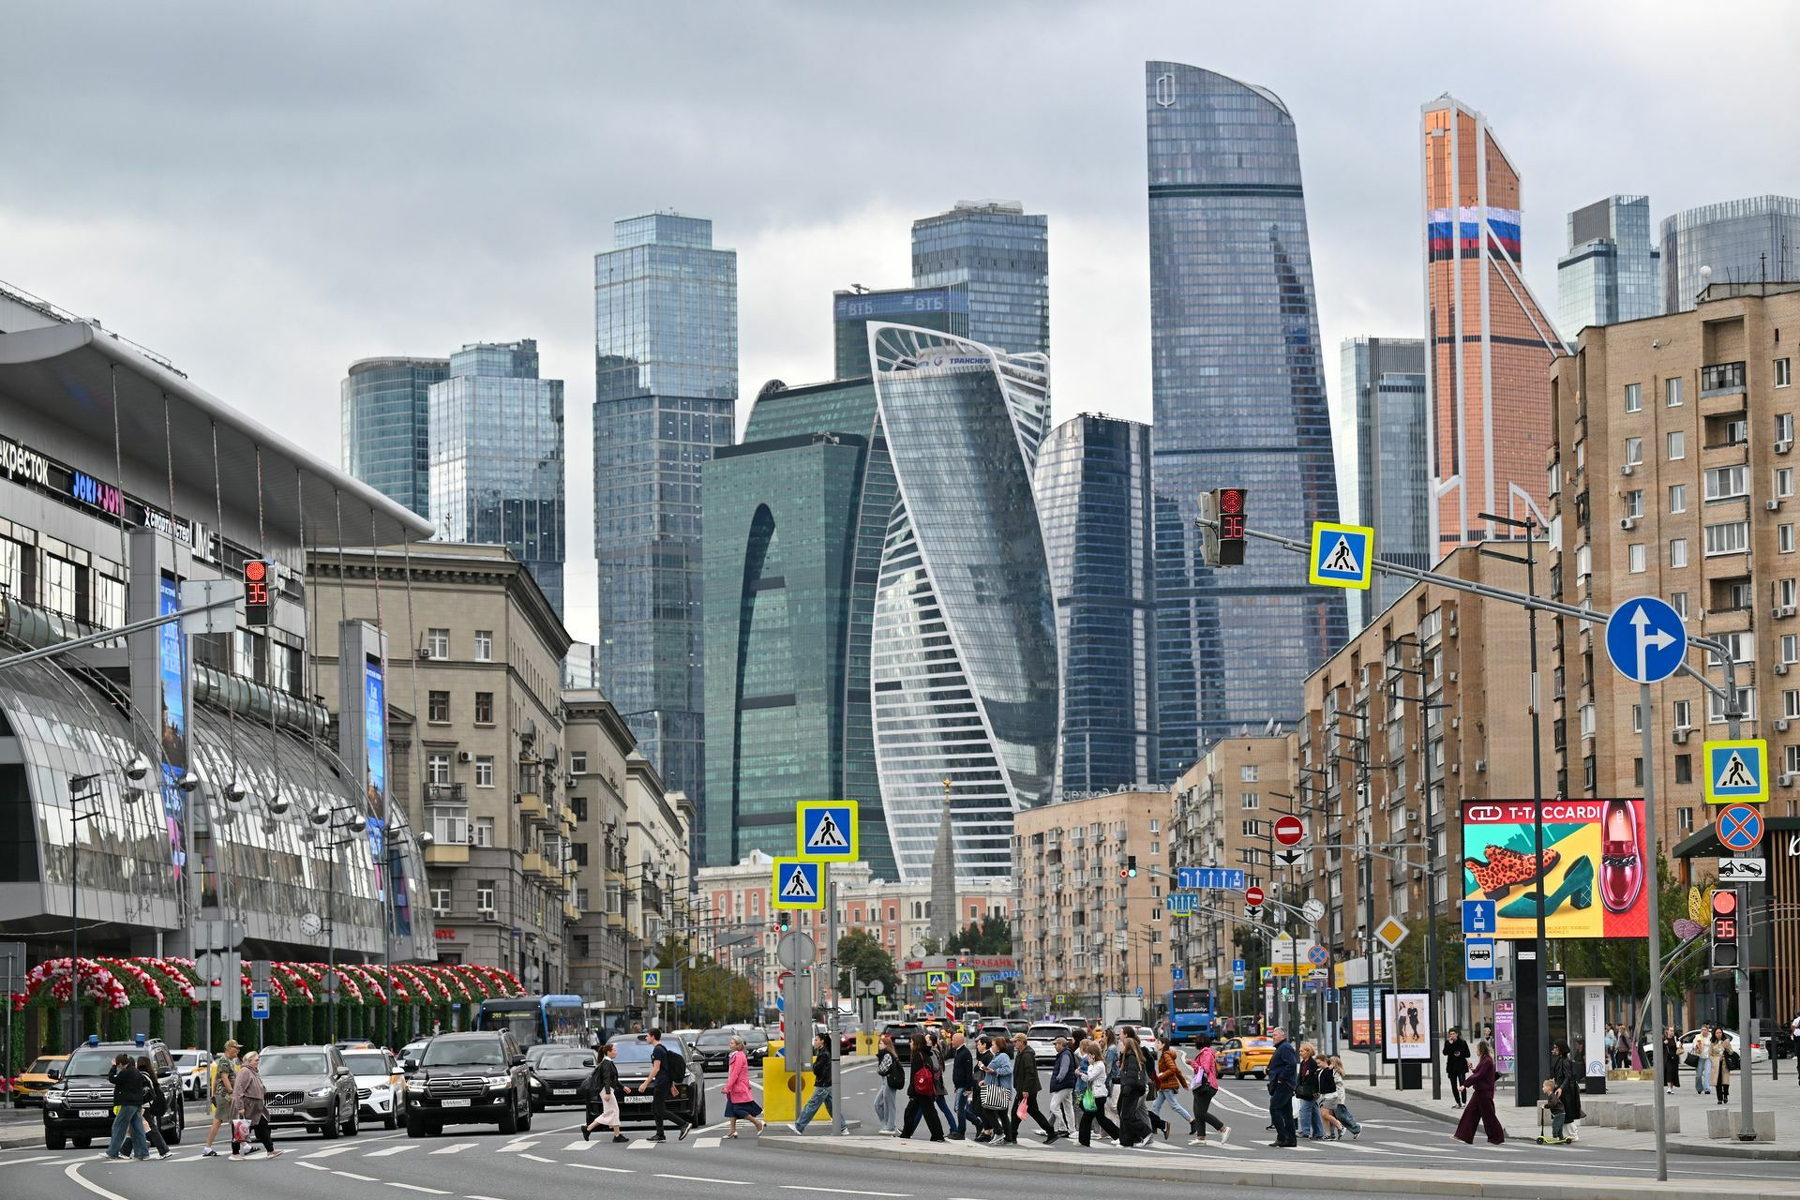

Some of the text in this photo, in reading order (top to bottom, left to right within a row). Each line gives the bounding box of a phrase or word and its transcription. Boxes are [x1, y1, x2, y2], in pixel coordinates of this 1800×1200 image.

[849, 301, 873, 316] ВТБ
[914, 297, 943, 311] ВТБ
[73, 470, 97, 504] JOKI
[1224, 517, 1243, 538] 36
[249, 583, 267, 603] 35
[1715, 920, 1735, 939] 35
